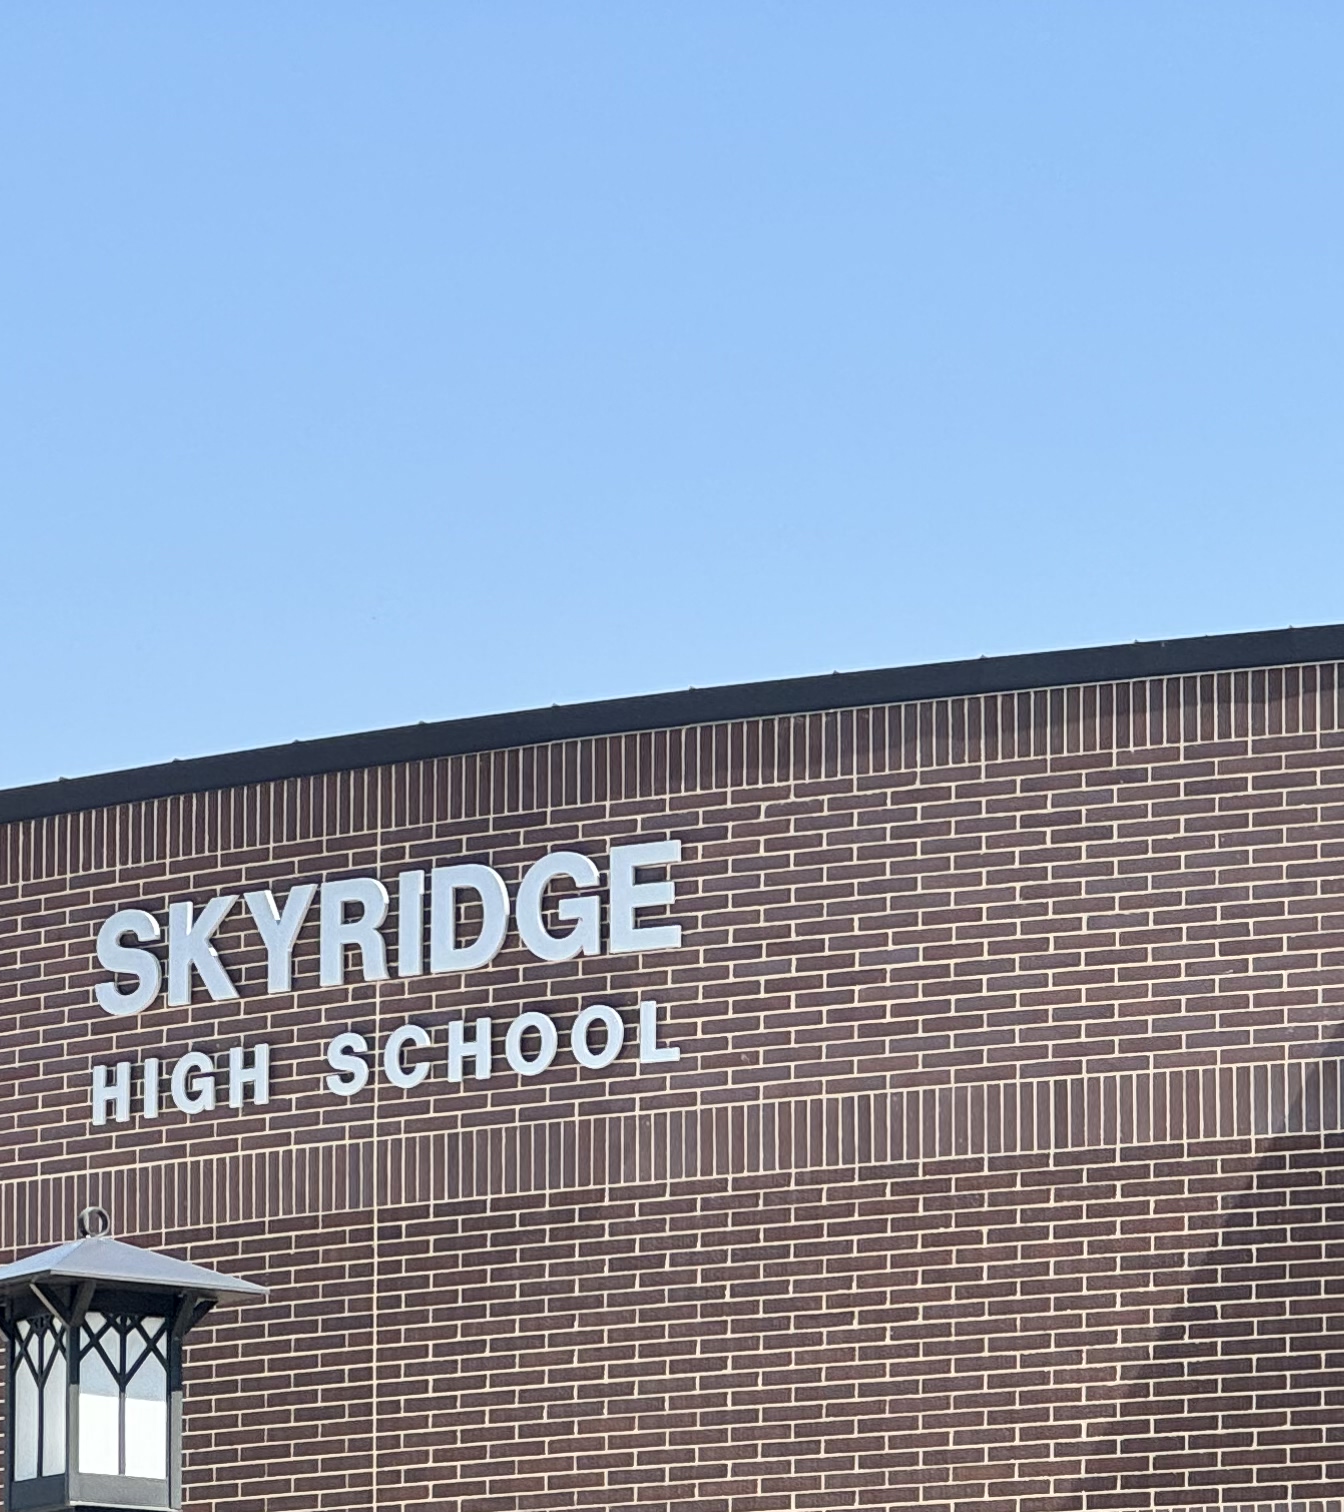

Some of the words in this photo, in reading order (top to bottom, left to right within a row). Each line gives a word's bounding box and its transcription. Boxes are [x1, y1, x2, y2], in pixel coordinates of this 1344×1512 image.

[95, 840, 681, 1016] SKYRIDGE
[92, 1043, 269, 1126] HIGH
[326, 1000, 681, 1096] SCHOOL
